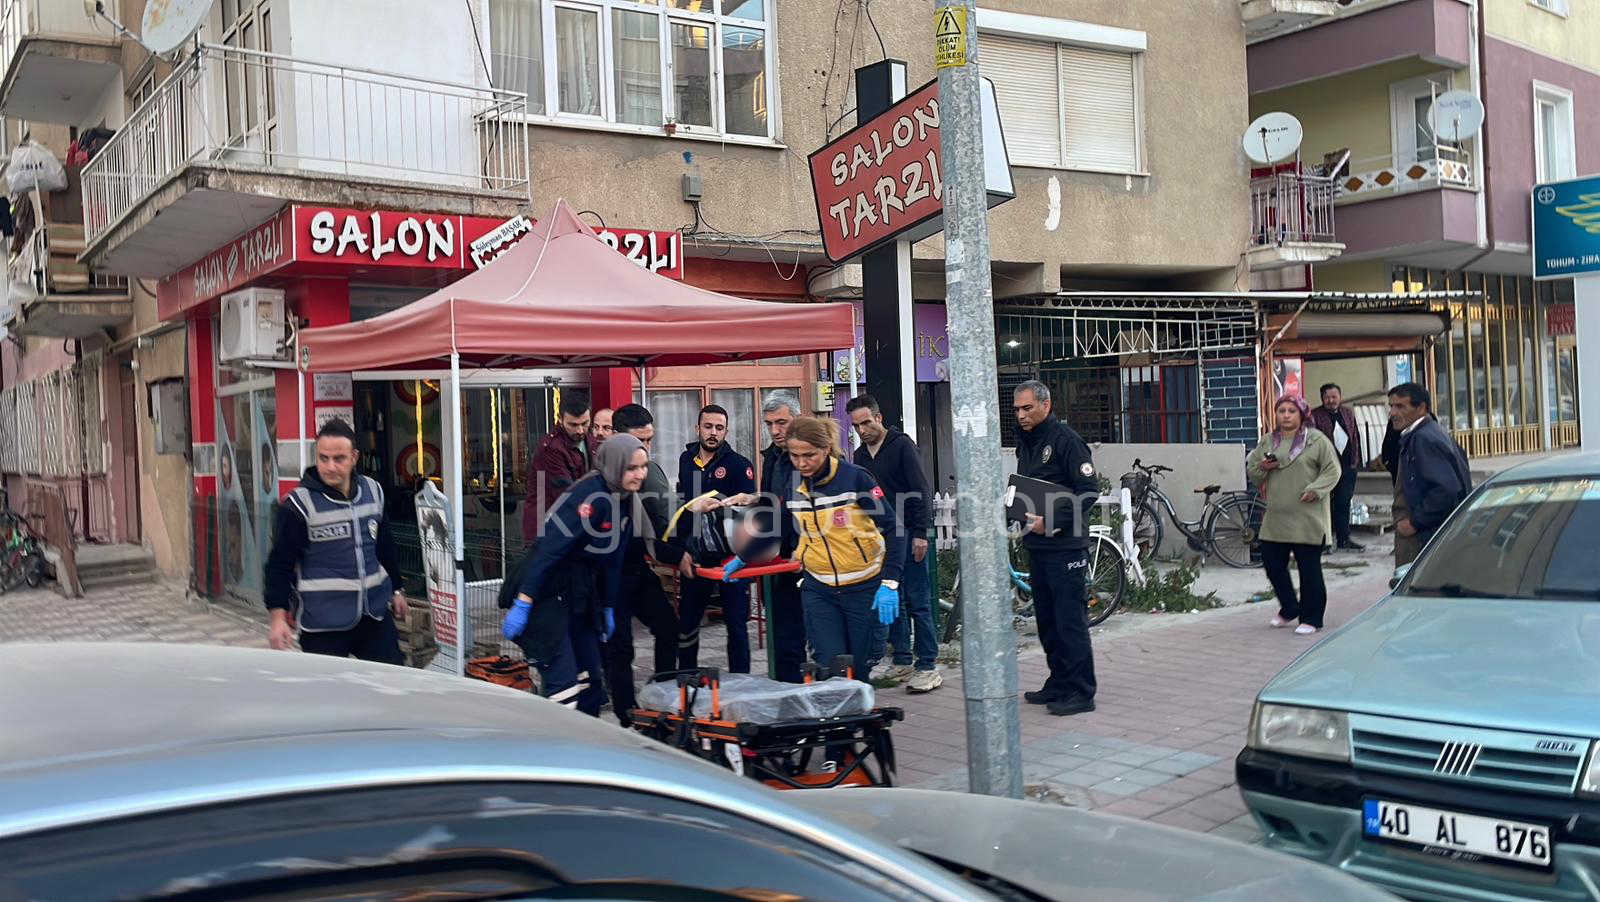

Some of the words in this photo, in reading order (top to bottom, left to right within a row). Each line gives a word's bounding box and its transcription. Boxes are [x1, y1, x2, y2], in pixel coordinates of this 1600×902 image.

[831, 97, 940, 187] SALON
[829, 150, 942, 239] TARZL
[194, 254, 224, 297] SALON
[242, 219, 283, 274] TARZLI
[310, 210, 454, 262] SALON
[597, 229, 677, 273] RZLI
[1546, 256, 1575, 268] TOHUM
[1381, 806, 1409, 836] 40
[1436, 815, 1468, 846] AL
[1496, 824, 1547, 859] 876
